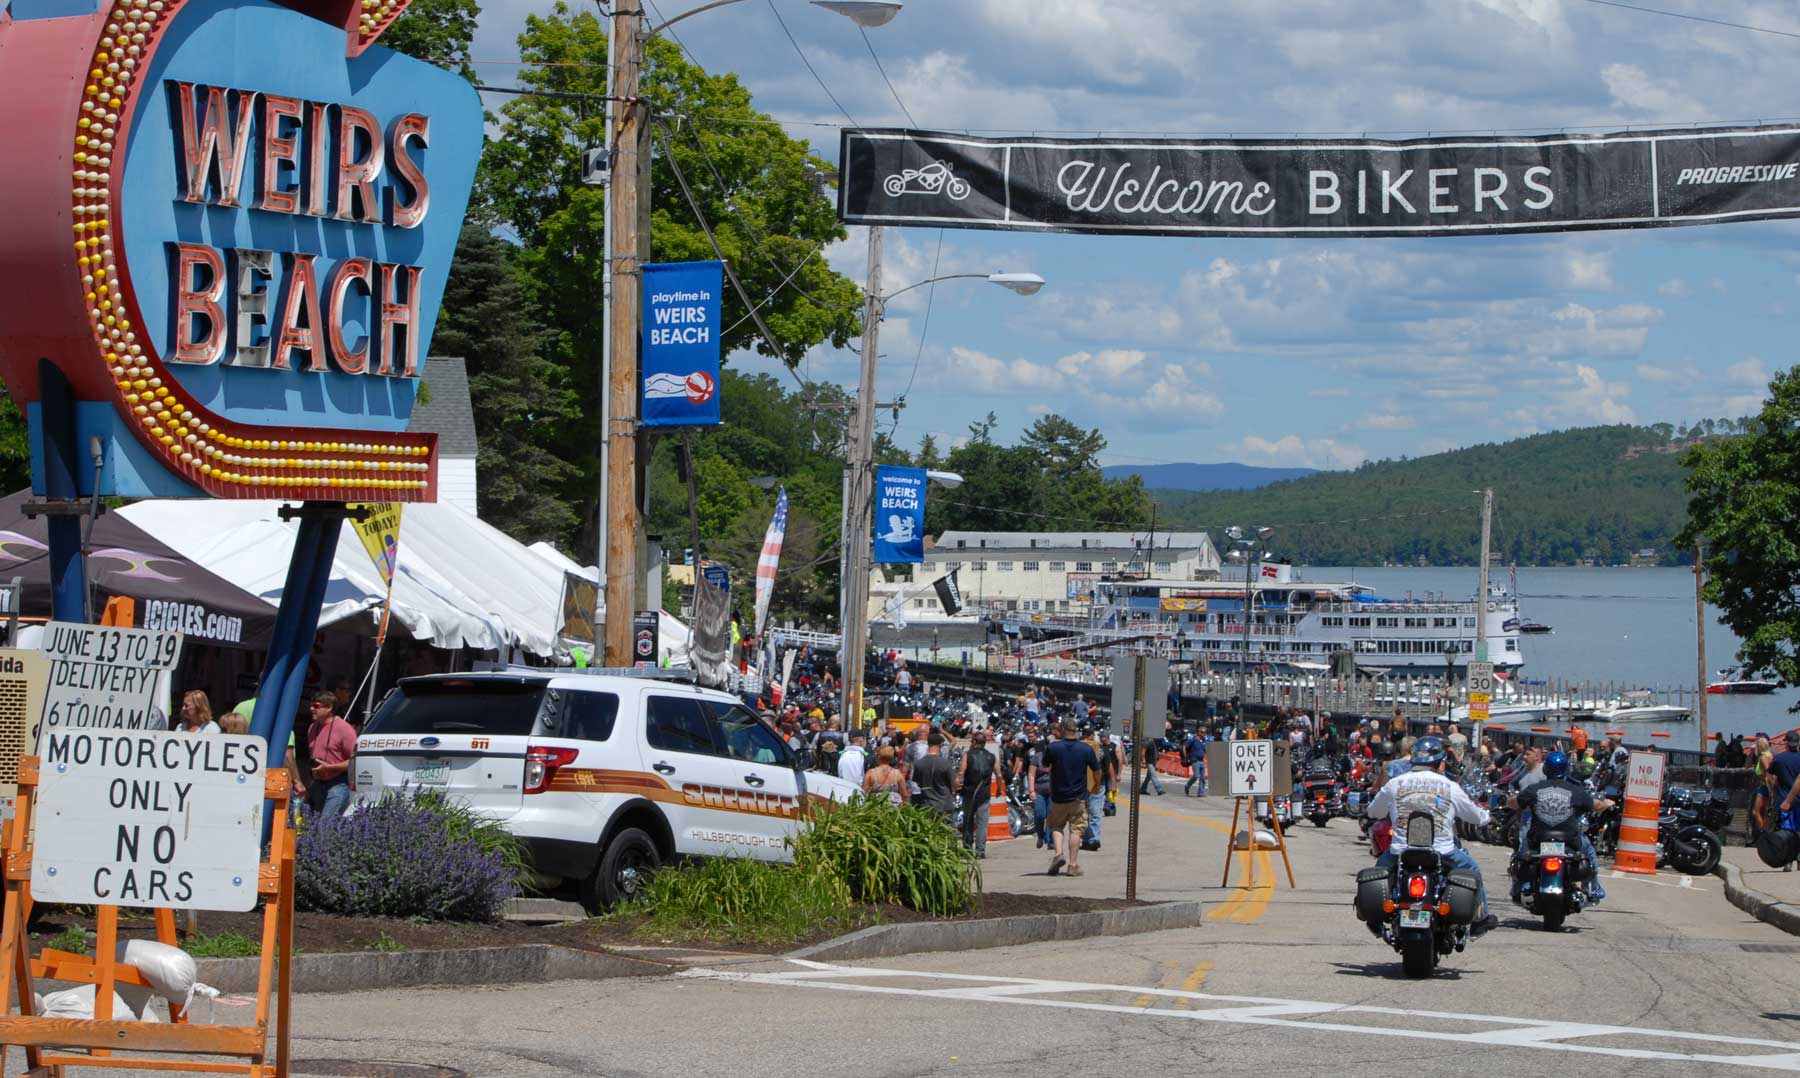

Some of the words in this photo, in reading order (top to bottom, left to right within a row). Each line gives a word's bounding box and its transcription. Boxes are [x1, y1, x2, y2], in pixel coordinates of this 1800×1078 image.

[165, 80, 429, 229] WEIRS
[1676, 162, 1799, 186] PROGRESSIVE
[1056, 160, 1276, 216] Welcome
[1308, 166, 1554, 215] BIKERS
[652, 291, 699, 304] playtime
[700, 290, 710, 301] in
[165, 241, 425, 378] BEACH
[655, 306, 706, 324] WEIRS
[651, 327, 710, 345] BEACH
[882, 476, 913, 485] welcome
[914, 477, 921, 485] to
[885, 486, 917, 498] WEIRS
[881, 498, 919, 510] BEACH
[362, 515, 398, 536] TODAY!
[46, 627, 95, 657] JUNE
[95, 630, 121, 663] 13
[124, 634, 148, 661] TO
[151, 634, 178, 667] 19
[55, 661, 151, 694] DELIVERY
[1470, 677, 1490, 690] 30
[48, 702, 60, 726] 6
[359, 738, 417, 749] SHERIFF
[471, 740, 489, 750] 911
[1236, 745, 1266, 758] ONE
[47, 734, 260, 775] MOTORCYLES
[1235, 760, 1266, 772] WAY
[1638, 765, 1653, 775] NO
[1629, 778, 1659, 788] PARKING
[109, 778, 192, 812] ONLY
[682, 783, 800, 817] SHERIFF
[116, 824, 176, 864] NO
[692, 831, 766, 846] HILLSBOROUGH
[93, 867, 194, 902] CARS
